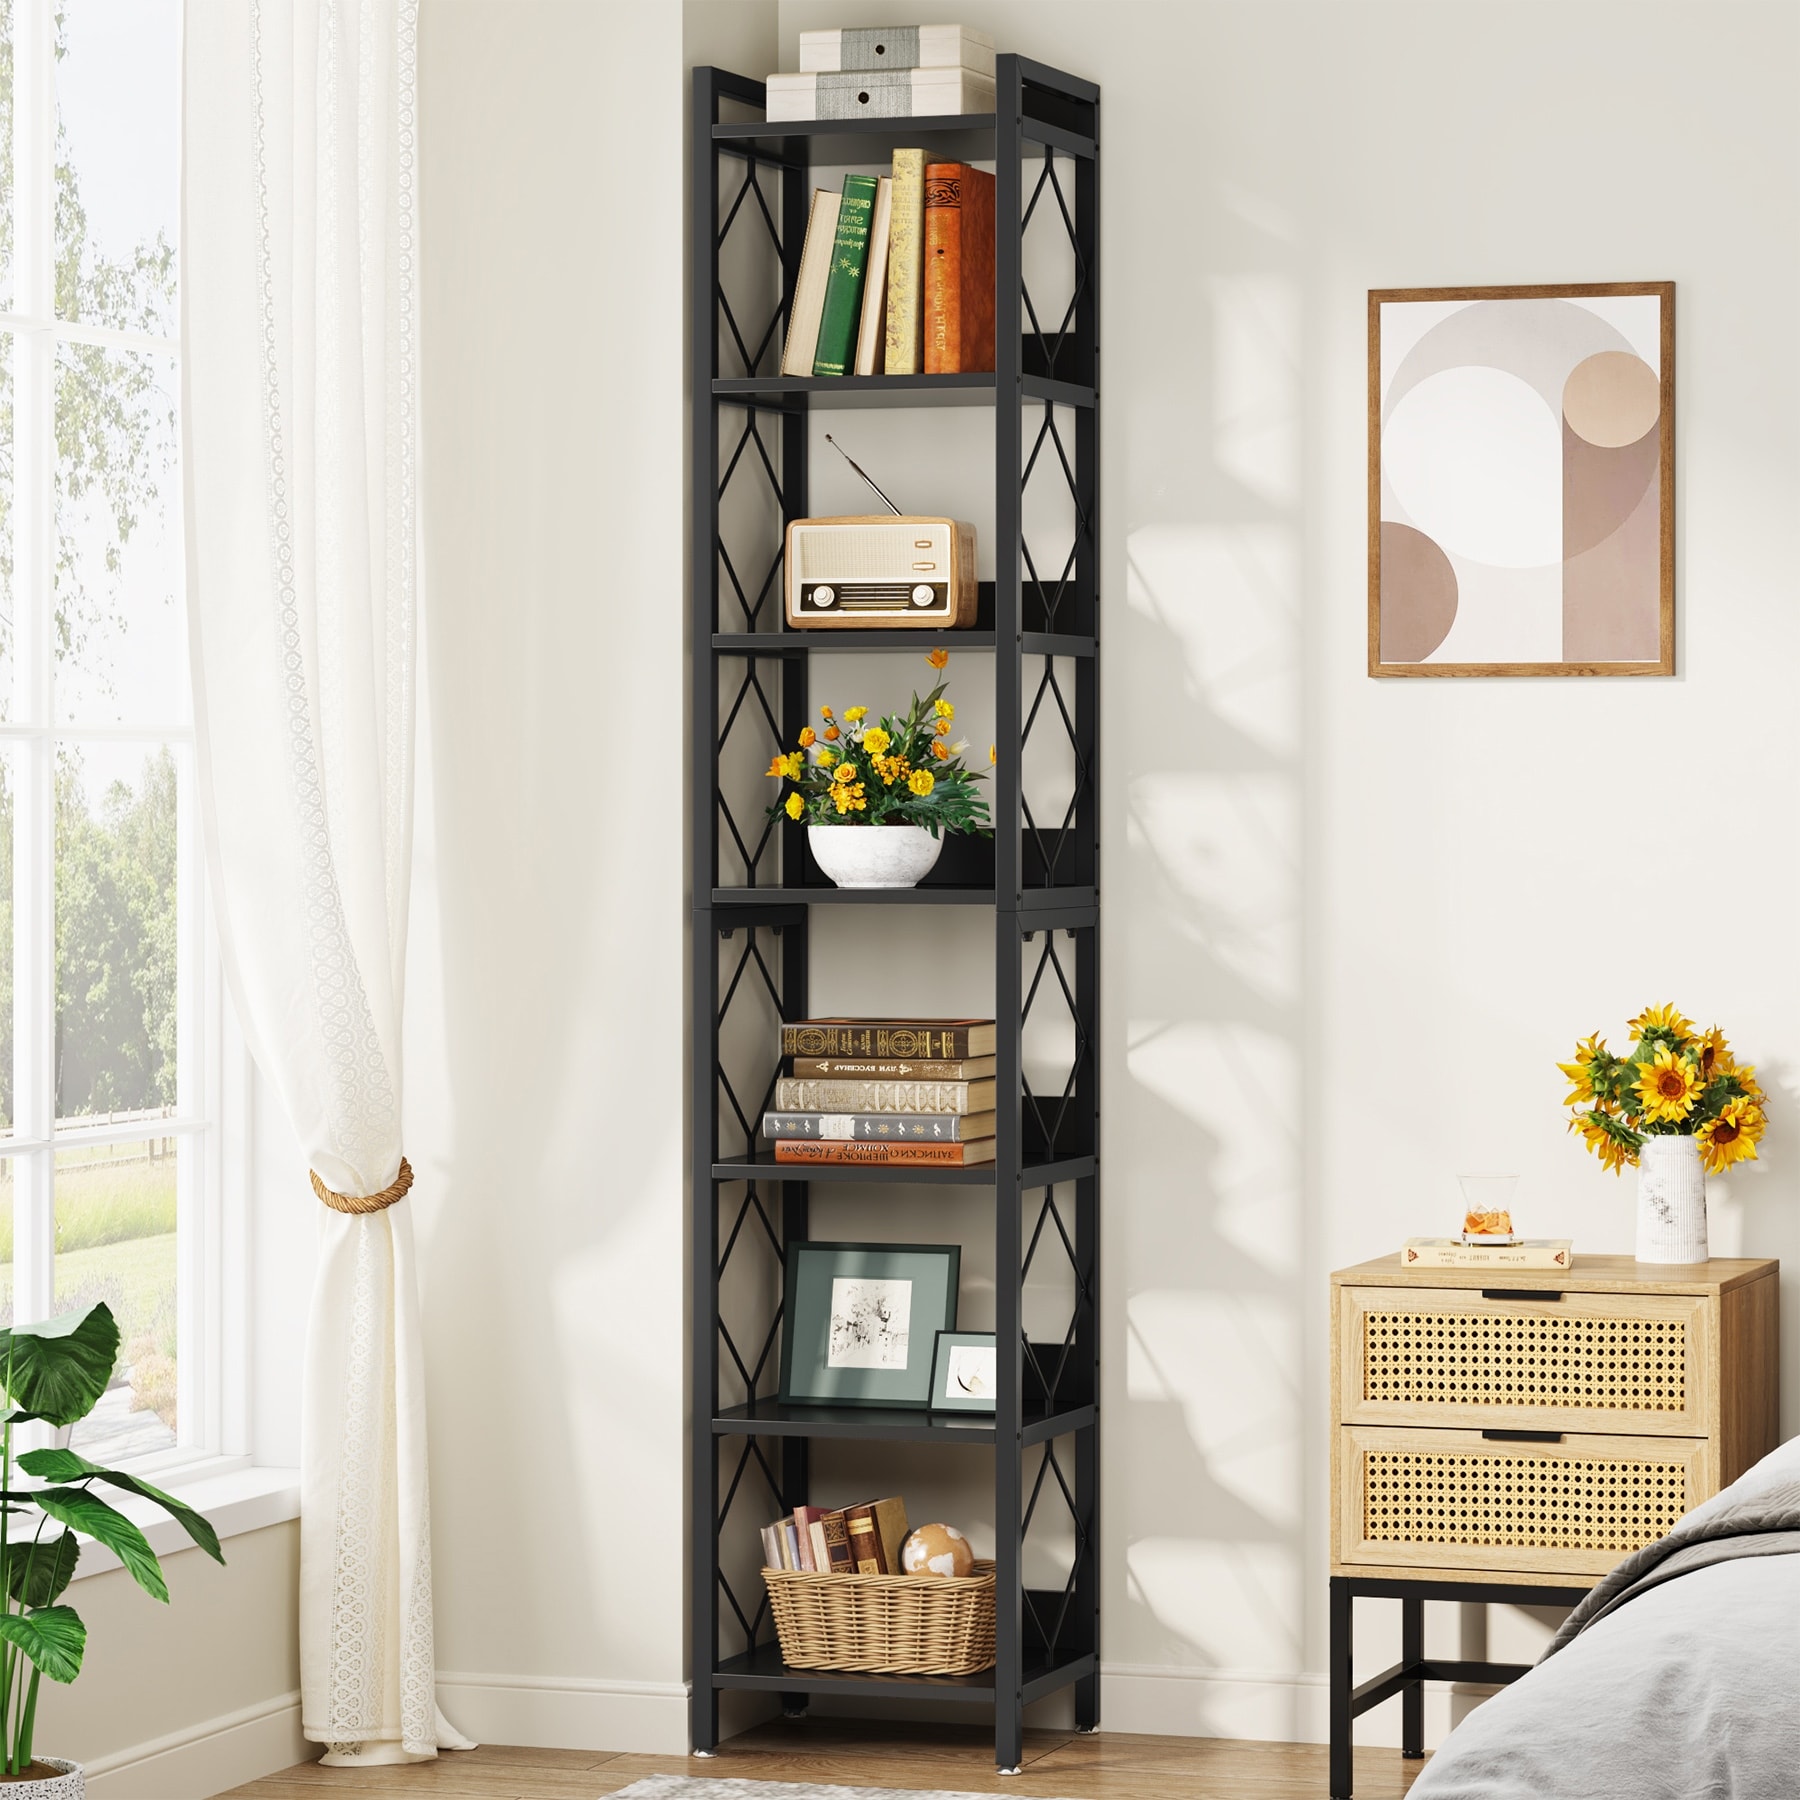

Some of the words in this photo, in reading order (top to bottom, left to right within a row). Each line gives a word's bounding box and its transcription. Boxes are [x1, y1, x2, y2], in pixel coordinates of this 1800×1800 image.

[837, 1152, 888, 1161] ШЕРЛОКЕ
[890, 1149, 899, 1157] О
[901, 1150, 954, 1159] ЗАПИСКИ
